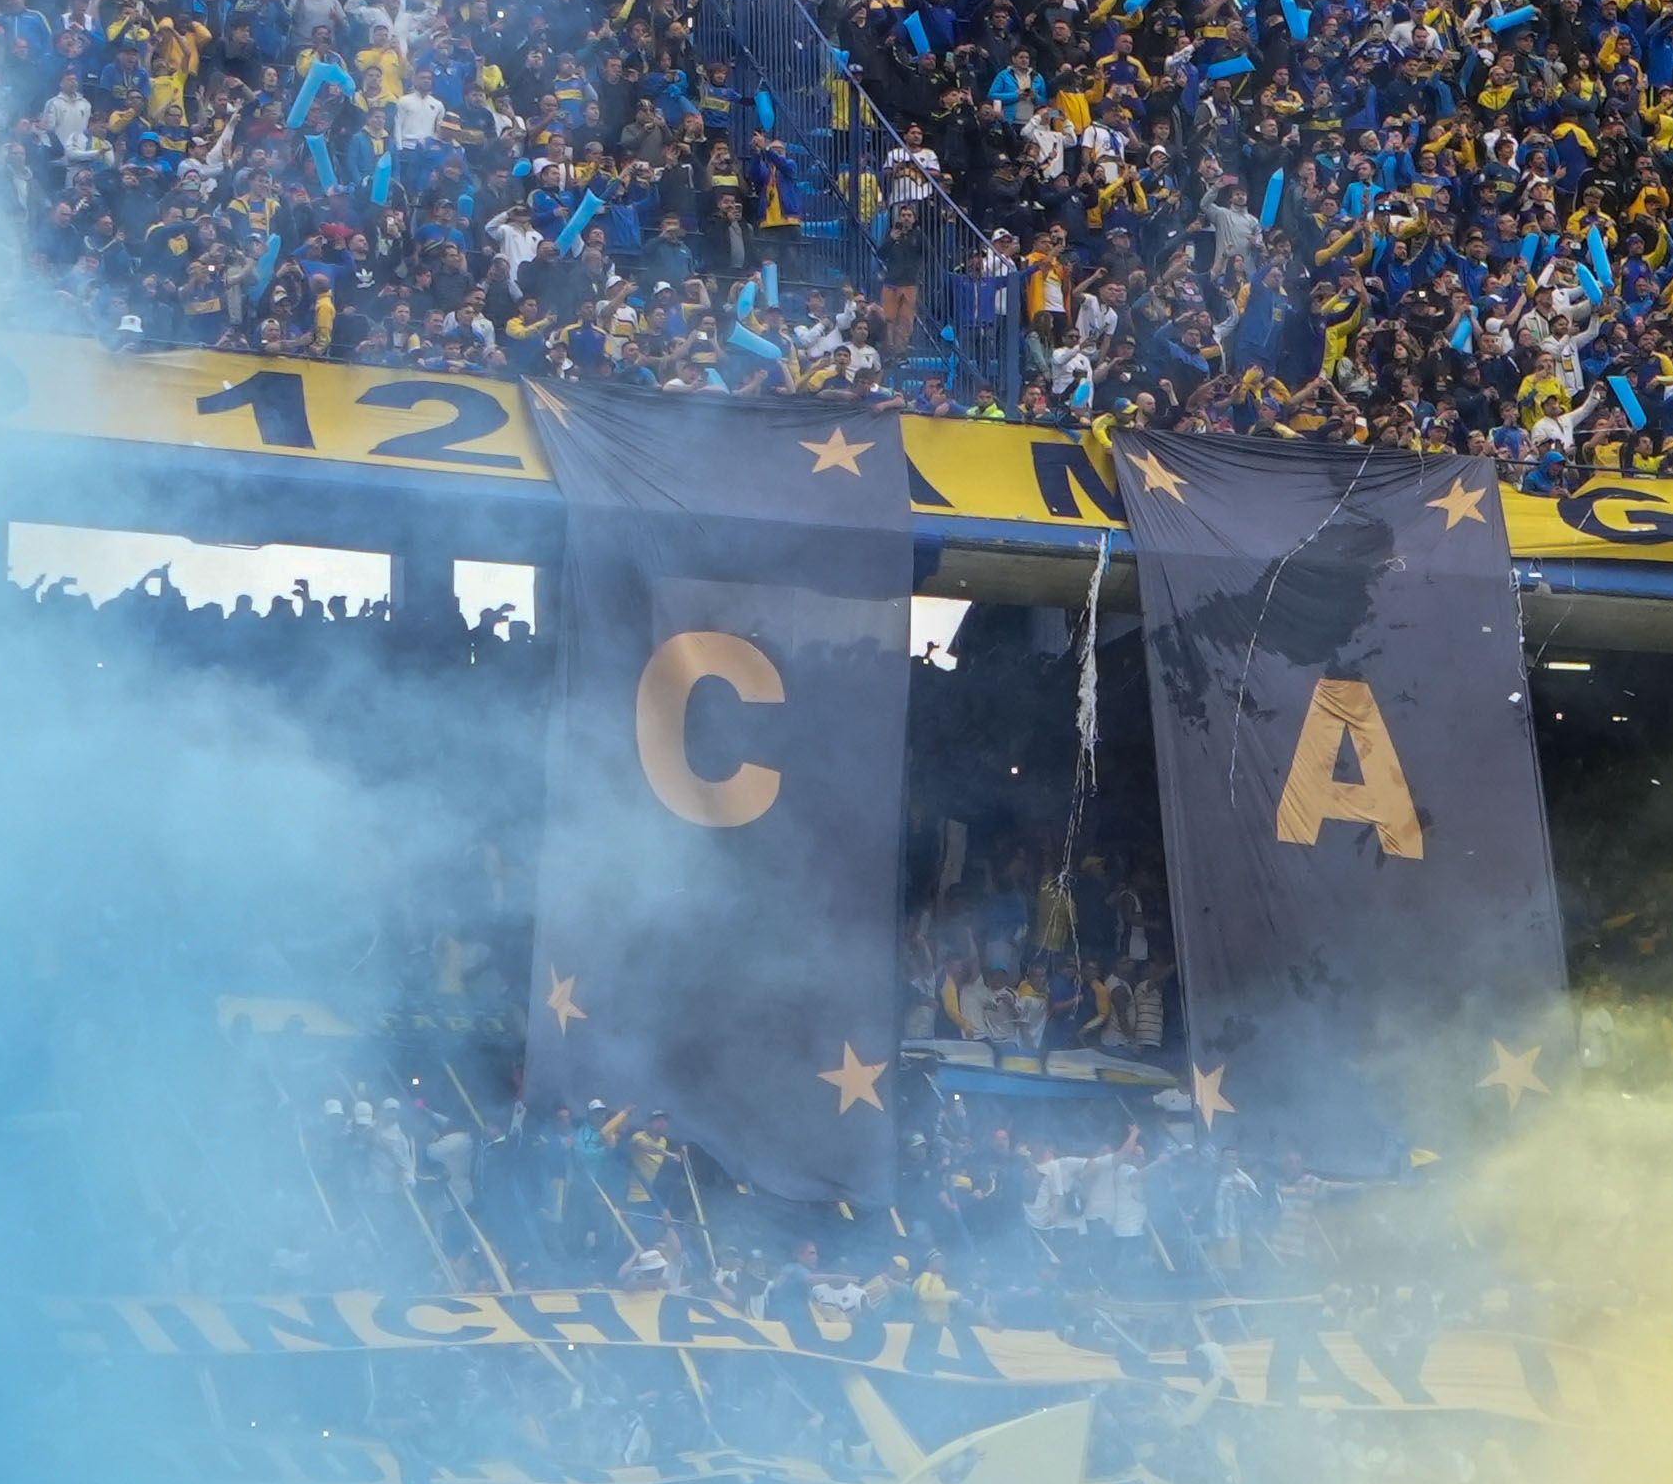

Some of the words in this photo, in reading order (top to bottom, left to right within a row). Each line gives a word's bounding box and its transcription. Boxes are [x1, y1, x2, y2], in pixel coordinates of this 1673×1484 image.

[196, 372, 523, 471] 12
[635, 631, 785, 827] C
[1276, 678, 1424, 859] A
